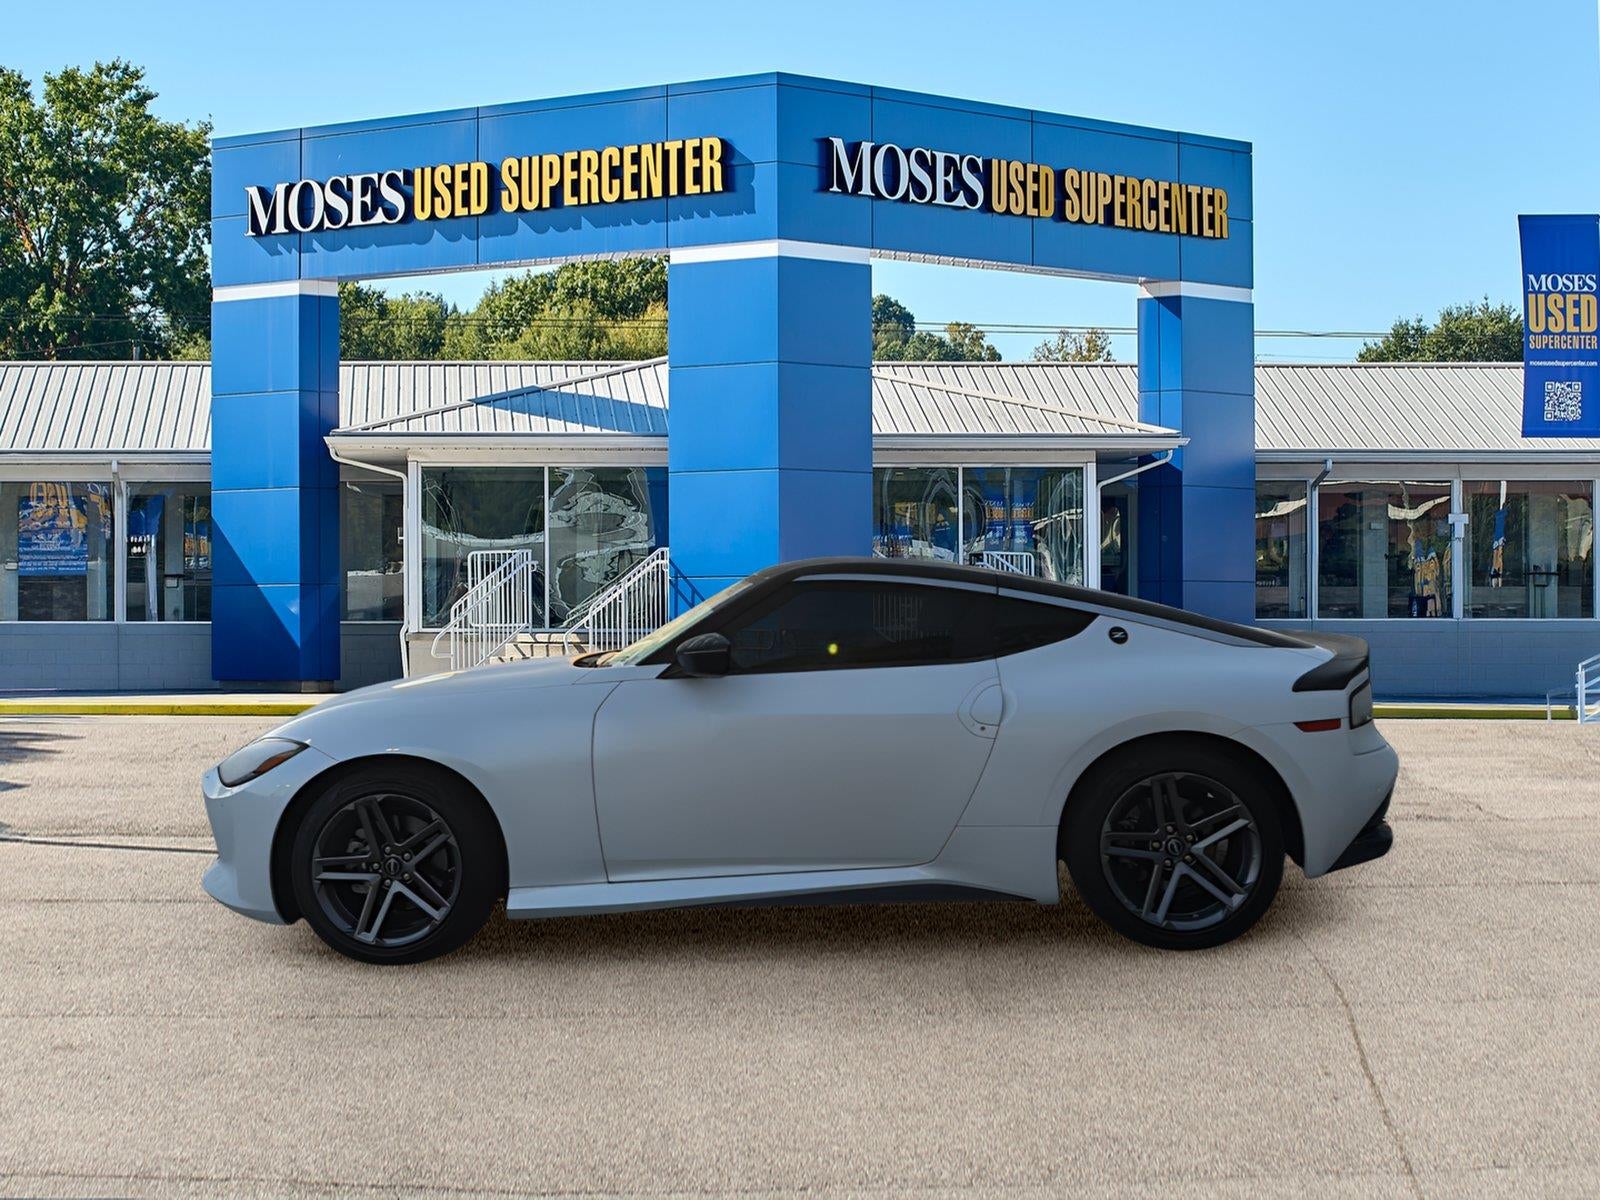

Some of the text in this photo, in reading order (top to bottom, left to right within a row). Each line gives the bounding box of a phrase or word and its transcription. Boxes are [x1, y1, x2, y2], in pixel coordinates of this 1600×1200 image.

[244, 136, 724, 237] MOSES USED SUPERCENTER
[828, 136, 1229, 239] MOSES USED SUPERCENTER
[1527, 273, 1597, 292] MOSES
[1528, 293, 1598, 333] USED
[1529, 334, 1598, 349] SUPERCENTER
